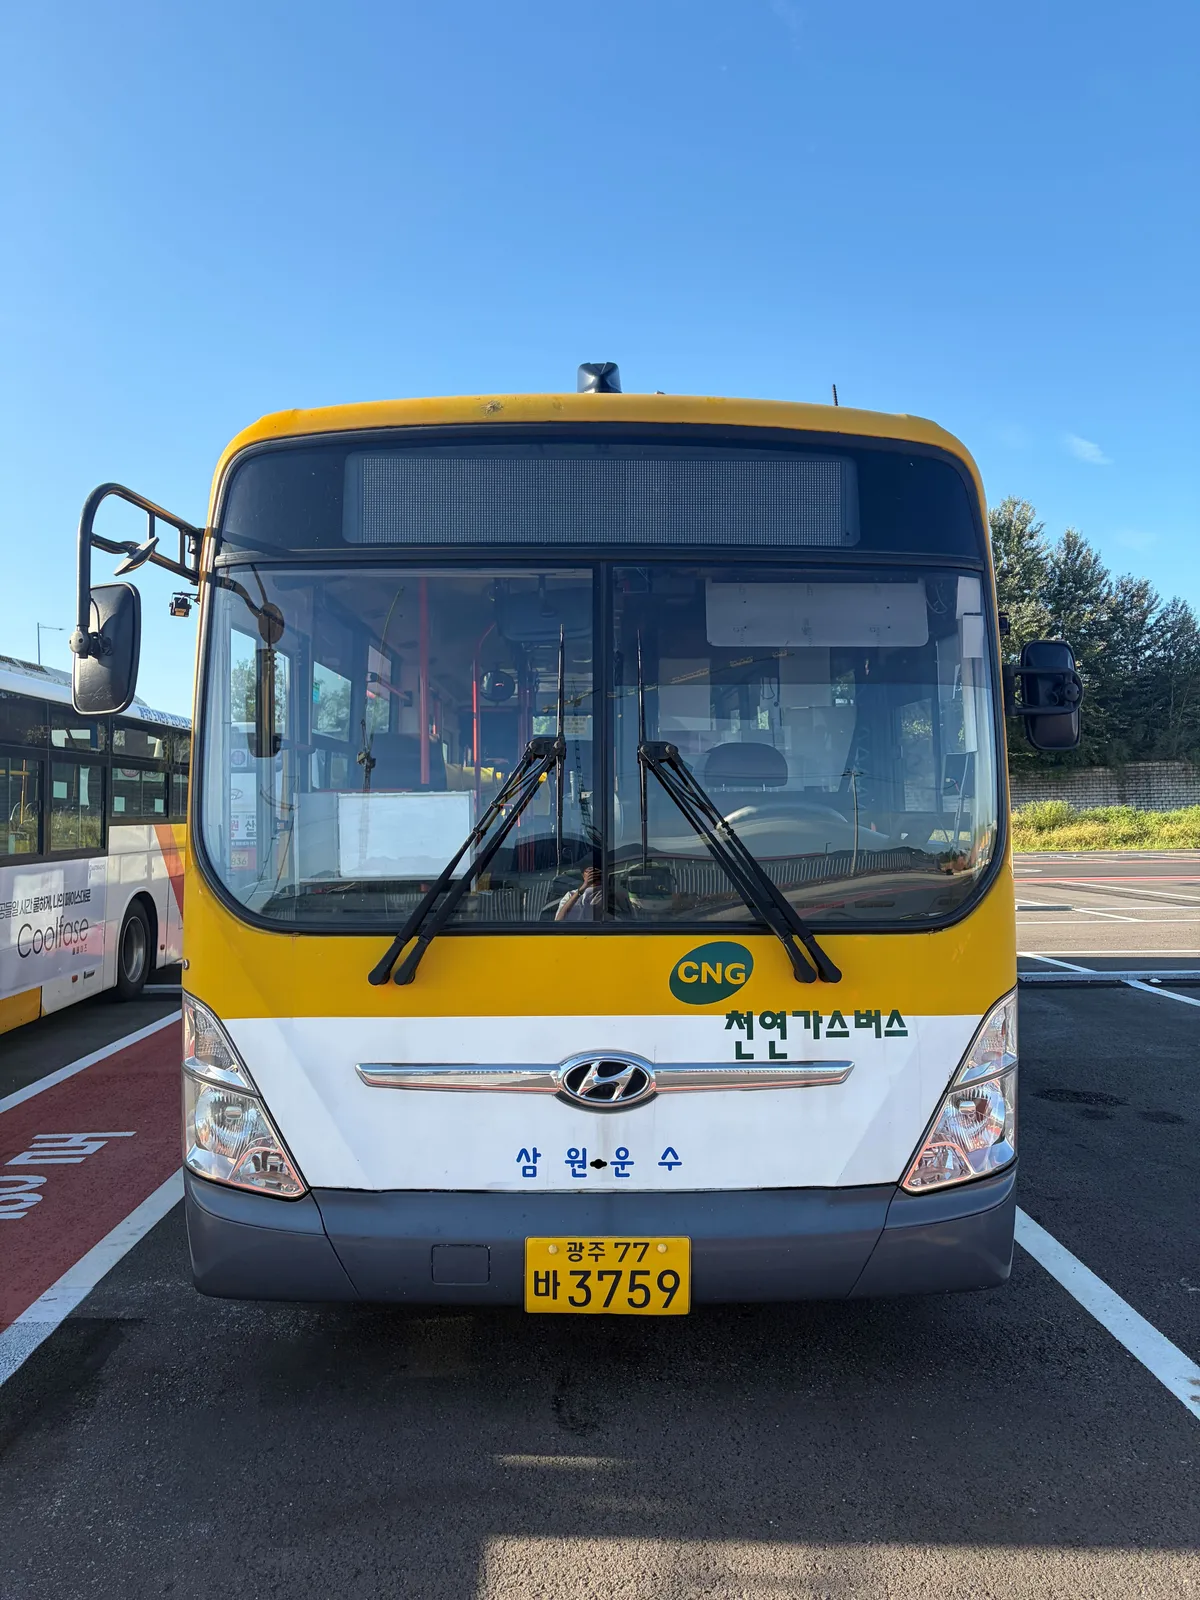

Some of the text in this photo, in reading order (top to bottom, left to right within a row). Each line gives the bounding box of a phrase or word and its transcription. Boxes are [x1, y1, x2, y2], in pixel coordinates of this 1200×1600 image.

[19, 898, 33, 915] 시간
[53, 892, 65, 909] 나의
[65, 888, 91, 907] 페이스대로
[17, 915, 89, 958] Coolfase
[677, 961, 746, 985] CNG
[724, 1009, 908, 1060] 천연가스버스
[566, 1242, 650, 1263] 광주 77
[533, 1269, 681, 1309] 바 3759
